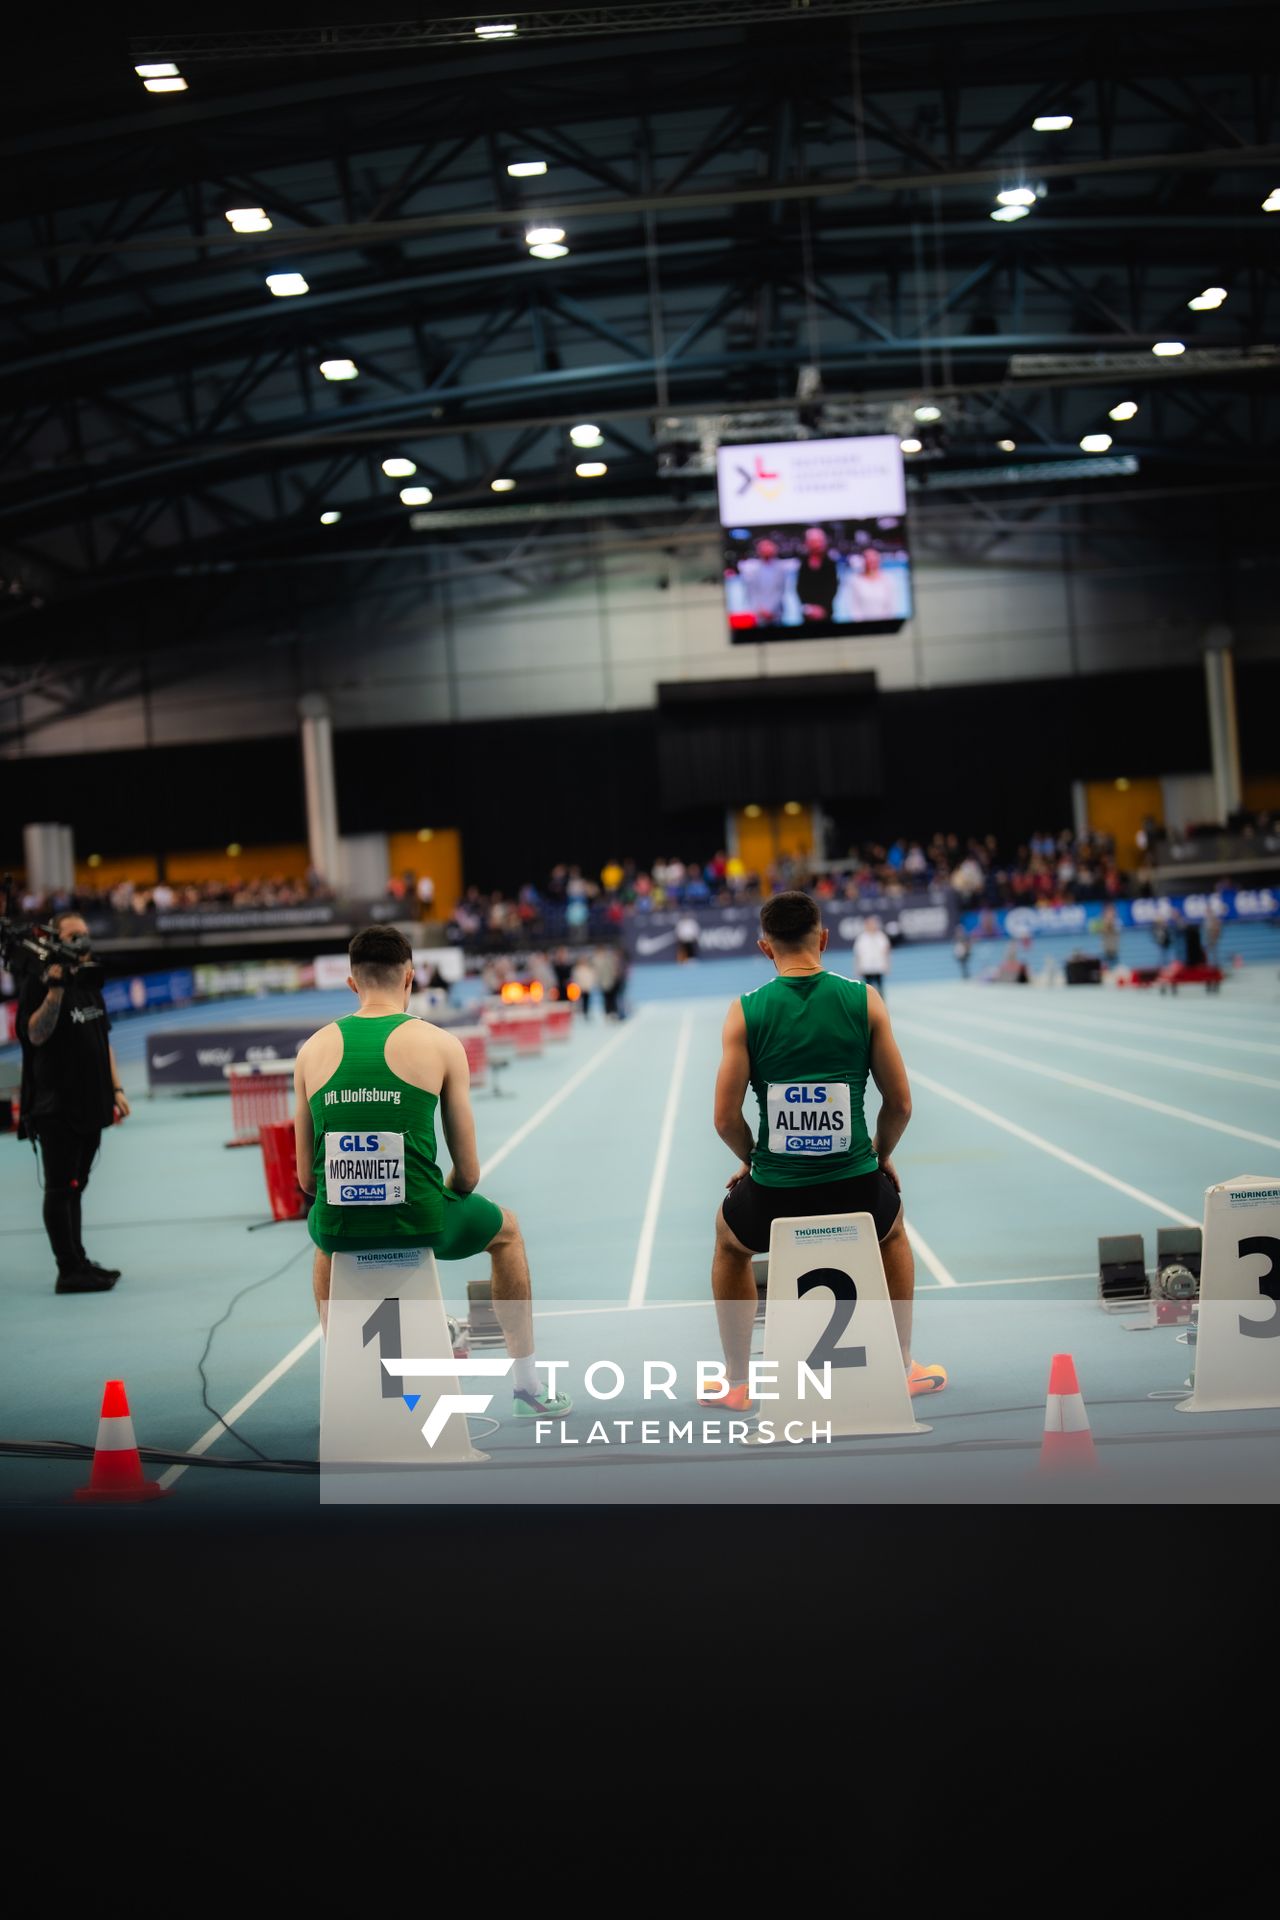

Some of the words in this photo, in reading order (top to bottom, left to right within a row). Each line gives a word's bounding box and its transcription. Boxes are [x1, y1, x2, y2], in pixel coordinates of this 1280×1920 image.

[324, 1090, 339, 1106] VfL
[340, 1087, 401, 1105] Wolfsburg
[776, 1110, 844, 1131] ALMAS
[804, 1138, 831, 1147] PLAN
[329, 1159, 401, 1180] MORAWIETZ
[358, 1186, 385, 1196] PLAN
[393, 1185, 401, 1198] 274
[1230, 1190, 1279, 1199] THÜRINGER
[794, 1226, 843, 1237] THÜRINGER
[356, 1252, 404, 1263] THÜRINGER
[1237, 1235, 1280, 1340] 3
[796, 1267, 867, 1369] 2
[362, 1297, 404, 1399] 1
